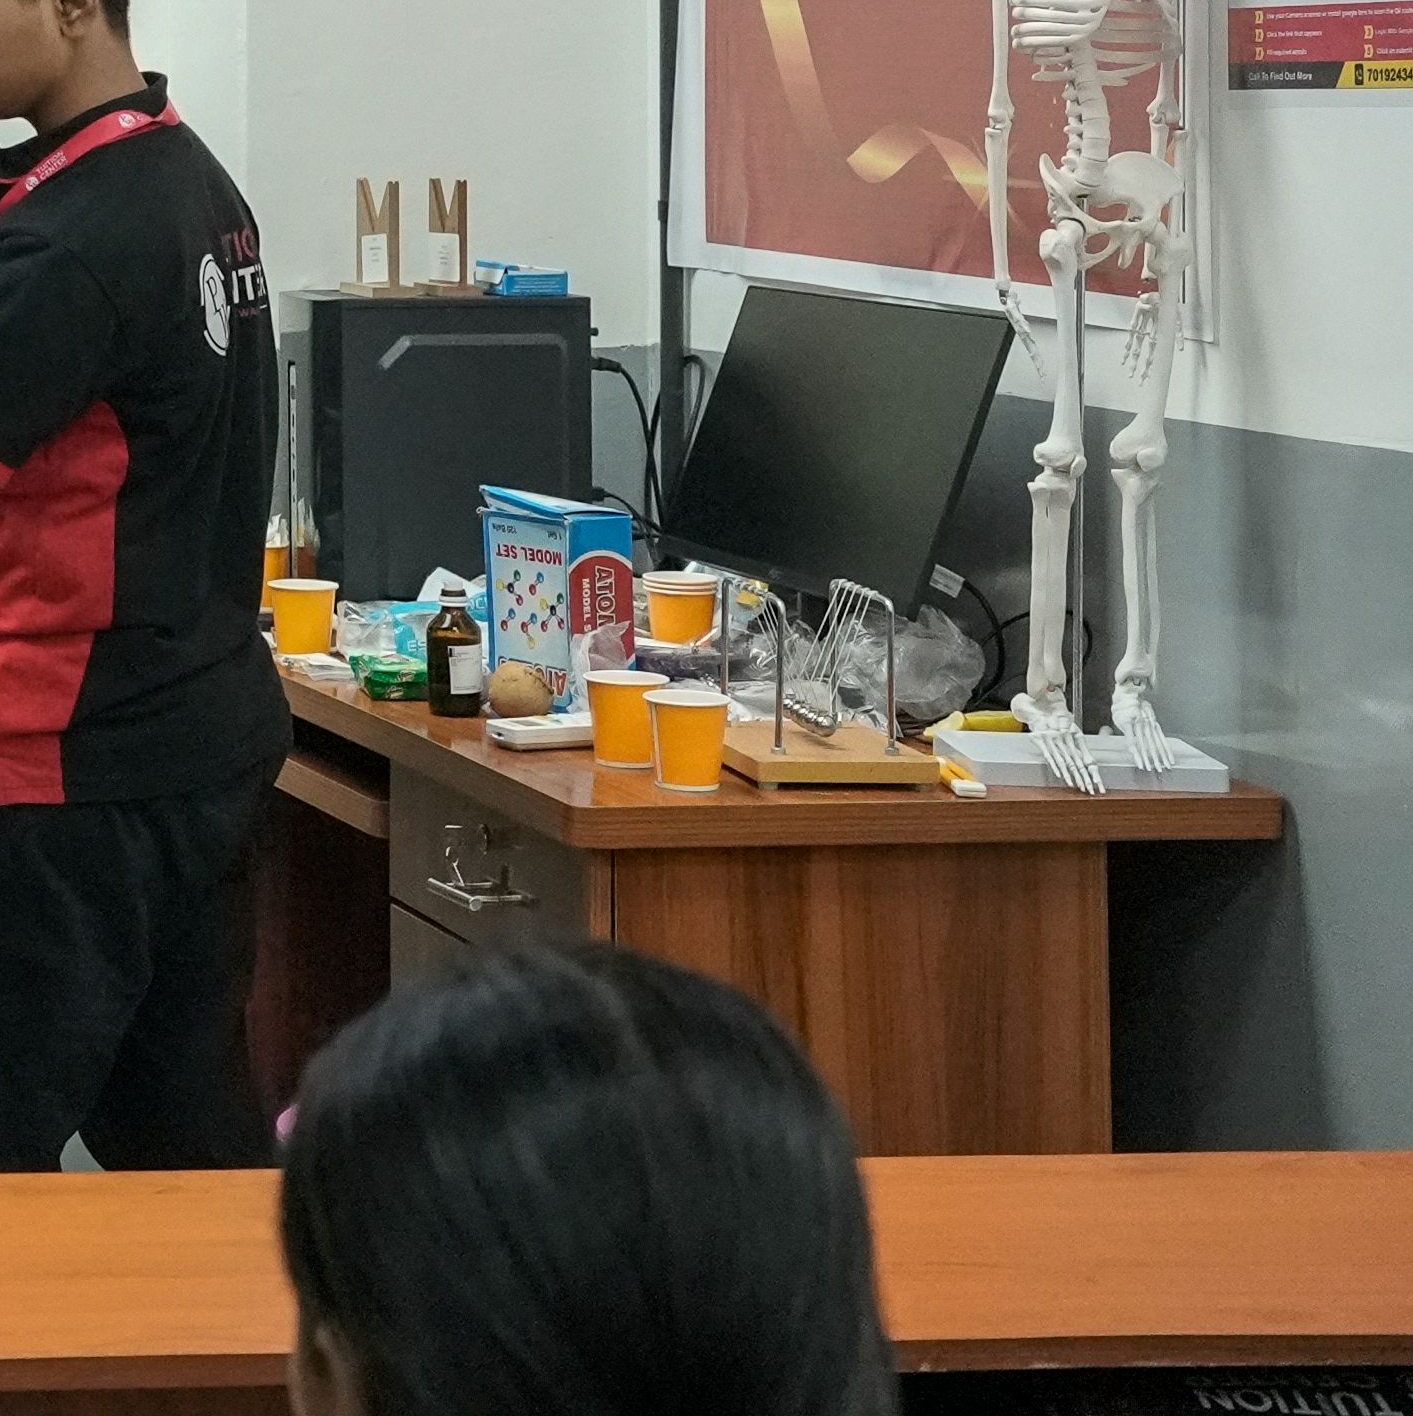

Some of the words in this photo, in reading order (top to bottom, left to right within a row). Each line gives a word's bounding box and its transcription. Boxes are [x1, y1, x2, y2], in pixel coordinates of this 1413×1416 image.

[1269, 71, 1284, 81] Find
[1284, 71, 1296, 81] Out
[1296, 71, 1313, 81] More
[495, 542, 518, 558] SET
[521, 547, 563, 566] MODEL
[581, 577, 592, 621] MODEL
